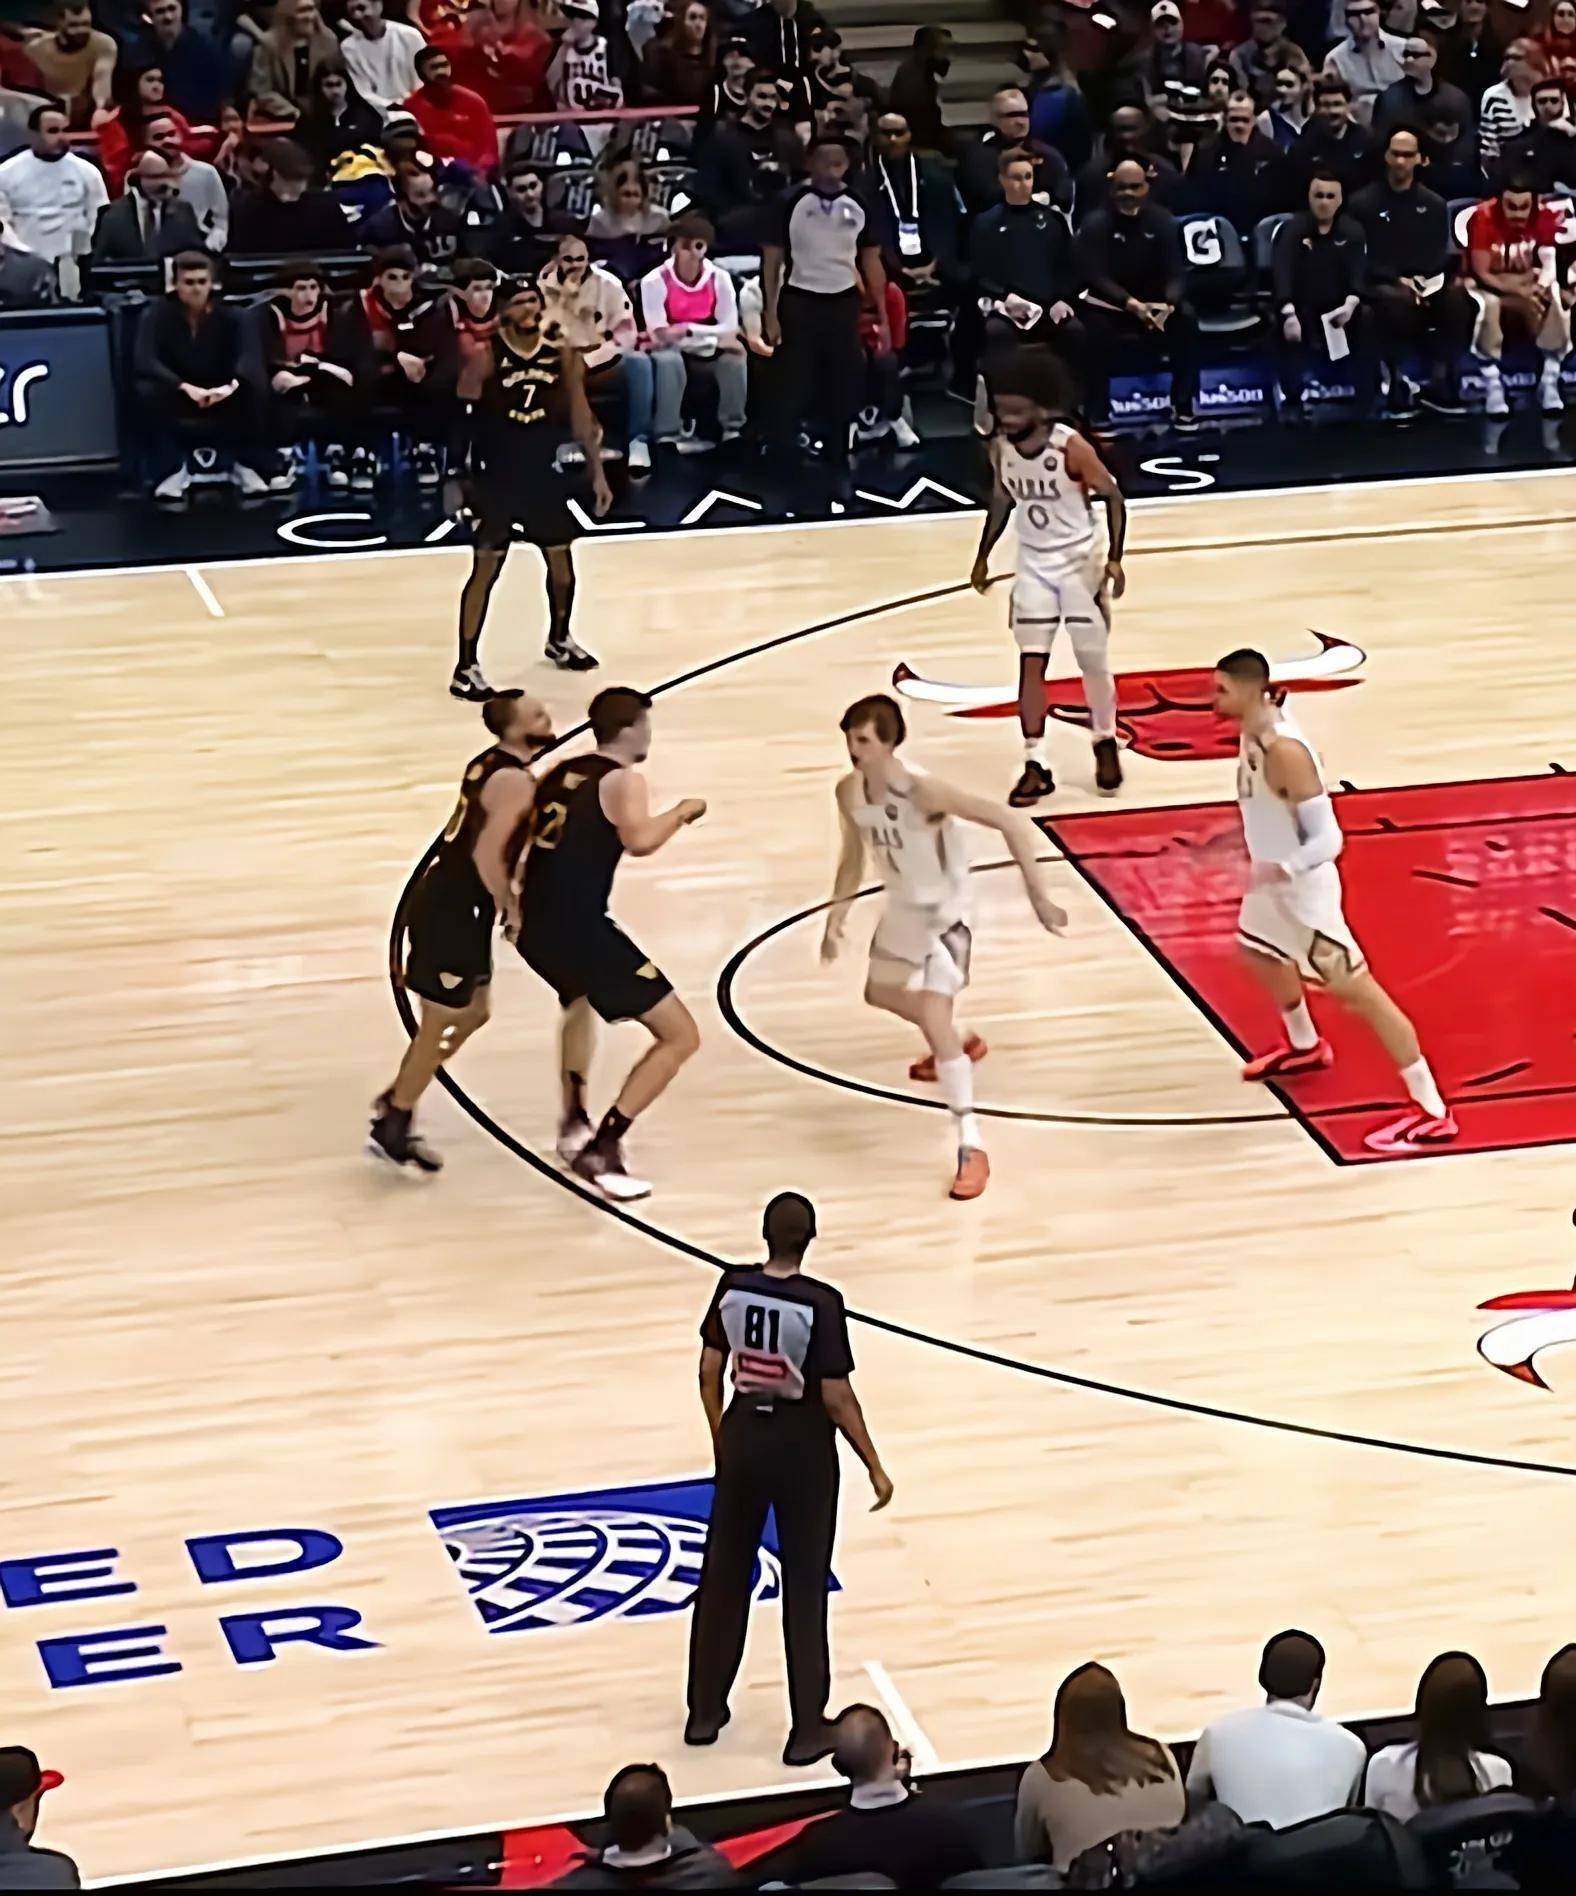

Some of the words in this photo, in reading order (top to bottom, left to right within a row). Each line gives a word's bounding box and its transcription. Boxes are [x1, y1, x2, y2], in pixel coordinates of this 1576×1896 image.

[523, 384, 537, 409] 7
[1027, 503, 1050, 531] 0
[743, 1304, 780, 1355] 81
